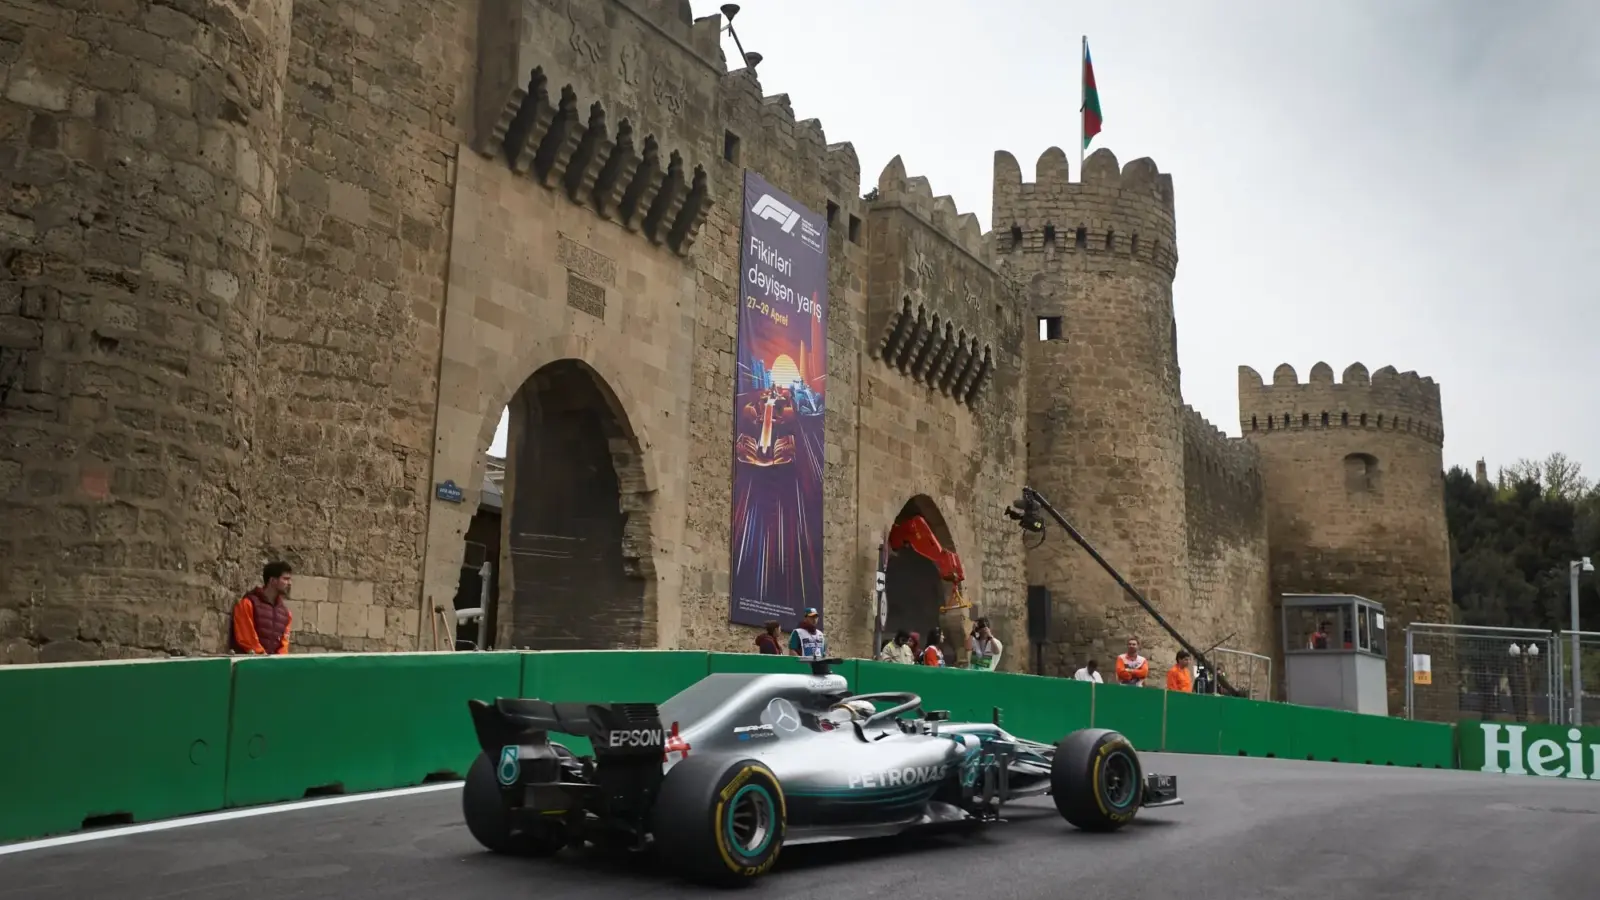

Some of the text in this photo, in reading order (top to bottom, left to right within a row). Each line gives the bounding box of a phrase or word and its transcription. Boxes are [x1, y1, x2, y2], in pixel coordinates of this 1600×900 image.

[751, 193, 801, 234] F1
[750, 236, 792, 277] Fikirləri
[748, 264, 822, 323] dəyişən yarış
[610, 729, 661, 747] EPSON
[848, 765, 948, 789] PETRONAS
